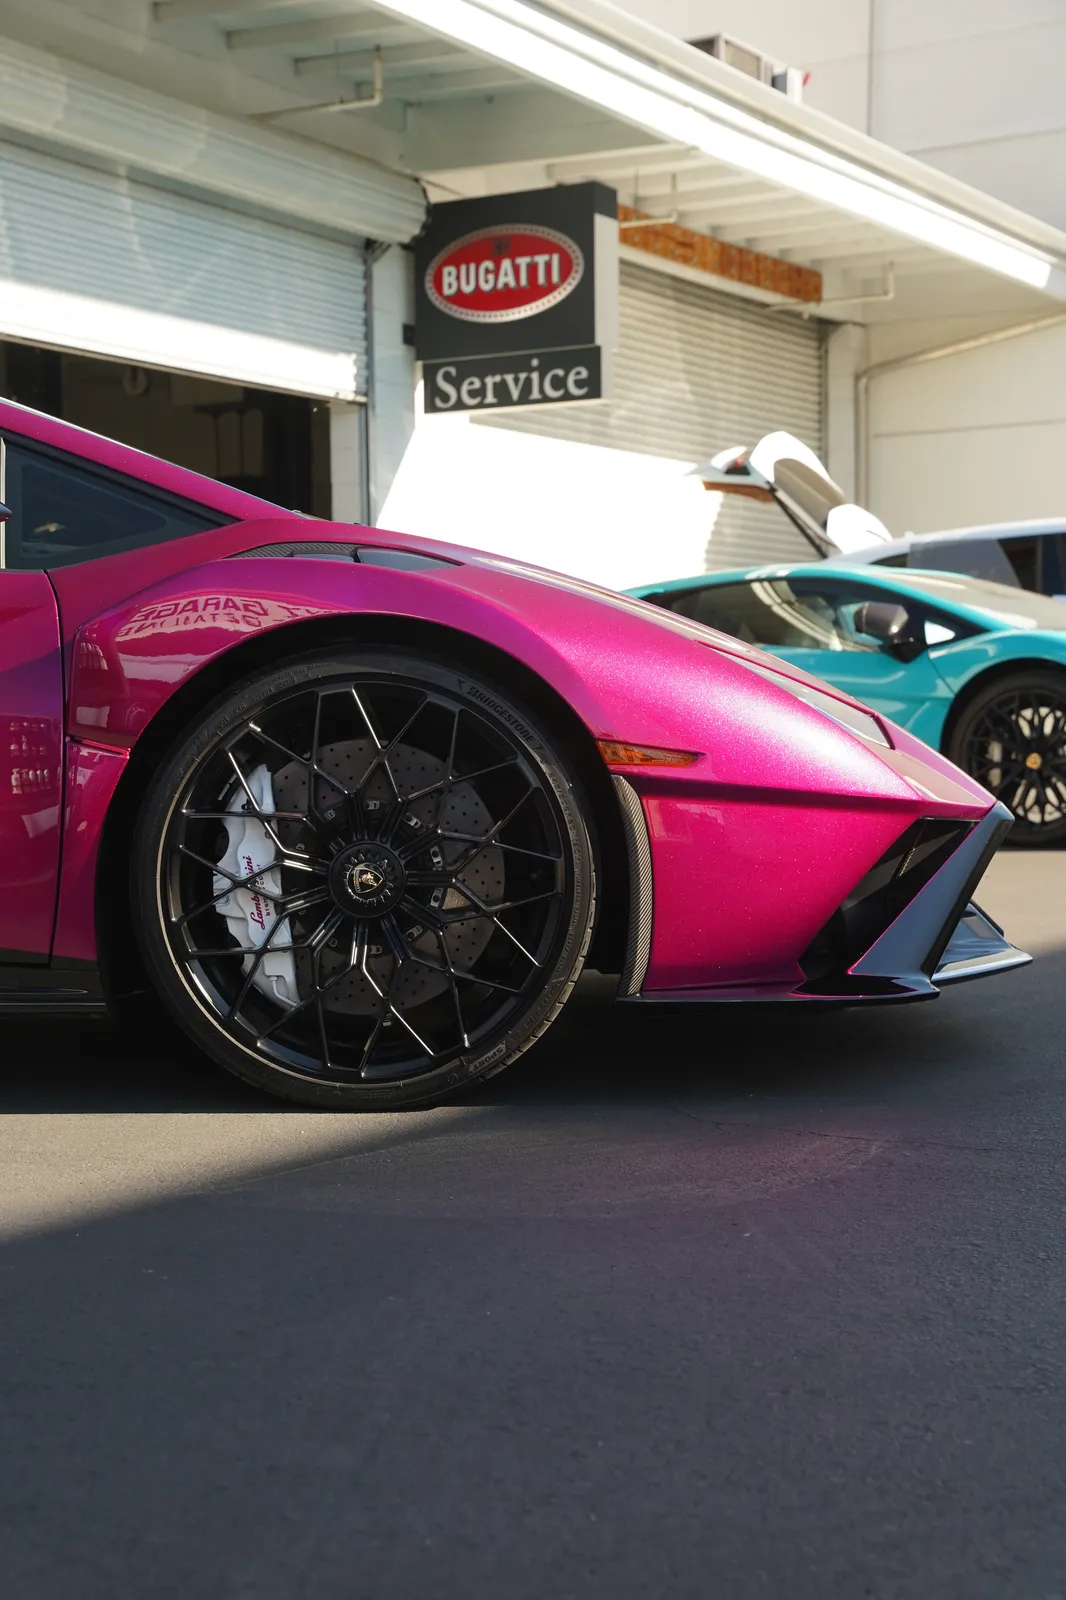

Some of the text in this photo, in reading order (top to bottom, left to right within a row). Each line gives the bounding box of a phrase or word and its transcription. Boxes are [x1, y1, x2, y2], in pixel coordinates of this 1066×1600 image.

[442, 252, 561, 297] BUGATTI
[434, 357, 590, 409] Service
[466, 685, 534, 744] BRIDGESTONE
[242, 855, 266, 930] Lambini
